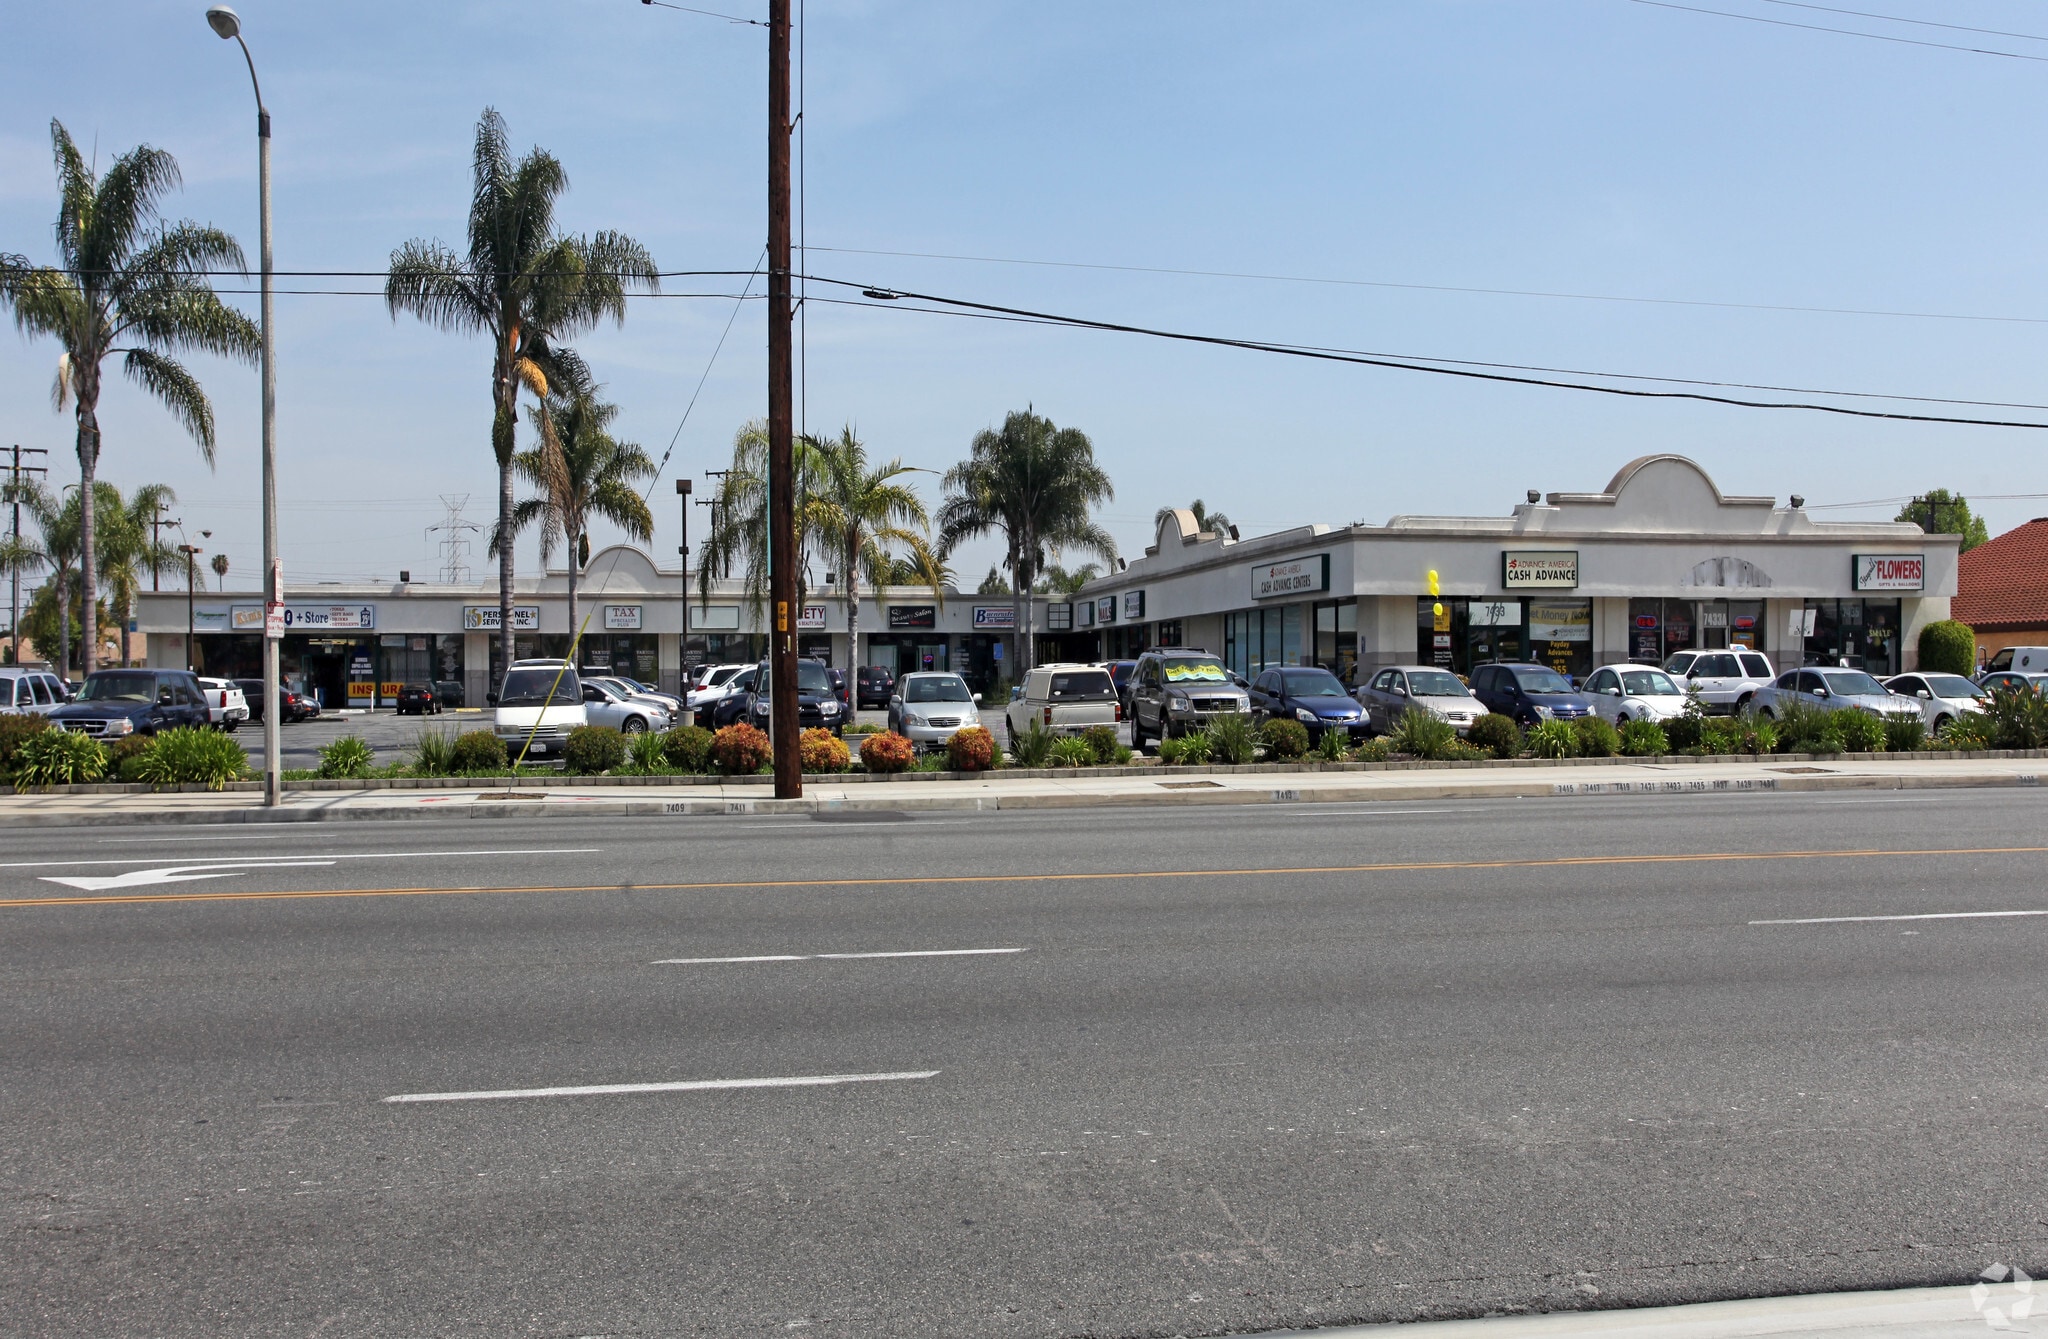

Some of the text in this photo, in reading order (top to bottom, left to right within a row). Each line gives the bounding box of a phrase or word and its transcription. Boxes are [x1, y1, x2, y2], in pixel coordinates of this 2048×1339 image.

[1877, 560, 1921, 579] FLOWERS
[1508, 570, 1575, 580] CASH ADVANCE
[1261, 574, 1311, 593] CASH ADVANCE CENTERS
[305, 611, 329, 623] Store
[612, 608, 635, 617] TAX
[804, 608, 825, 619] ETY
[914, 609, 932, 618] Salon
[1541, 611, 1569, 622] Money
[1704, 613, 1727, 625] 7433A
[1550, 641, 1570, 649] Payday
[352, 685, 373, 694] INS
[1559, 784, 1574, 793] 7415
[1586, 783, 1600, 792] 7417
[1616, 783, 1630, 791] 7419
[1640, 782, 1655, 791] 7421
[1666, 782, 1681, 790] 7423
[1689, 781, 1705, 790] 7425
[666, 803, 685, 813] 7409
[730, 803, 746, 812] 7411
